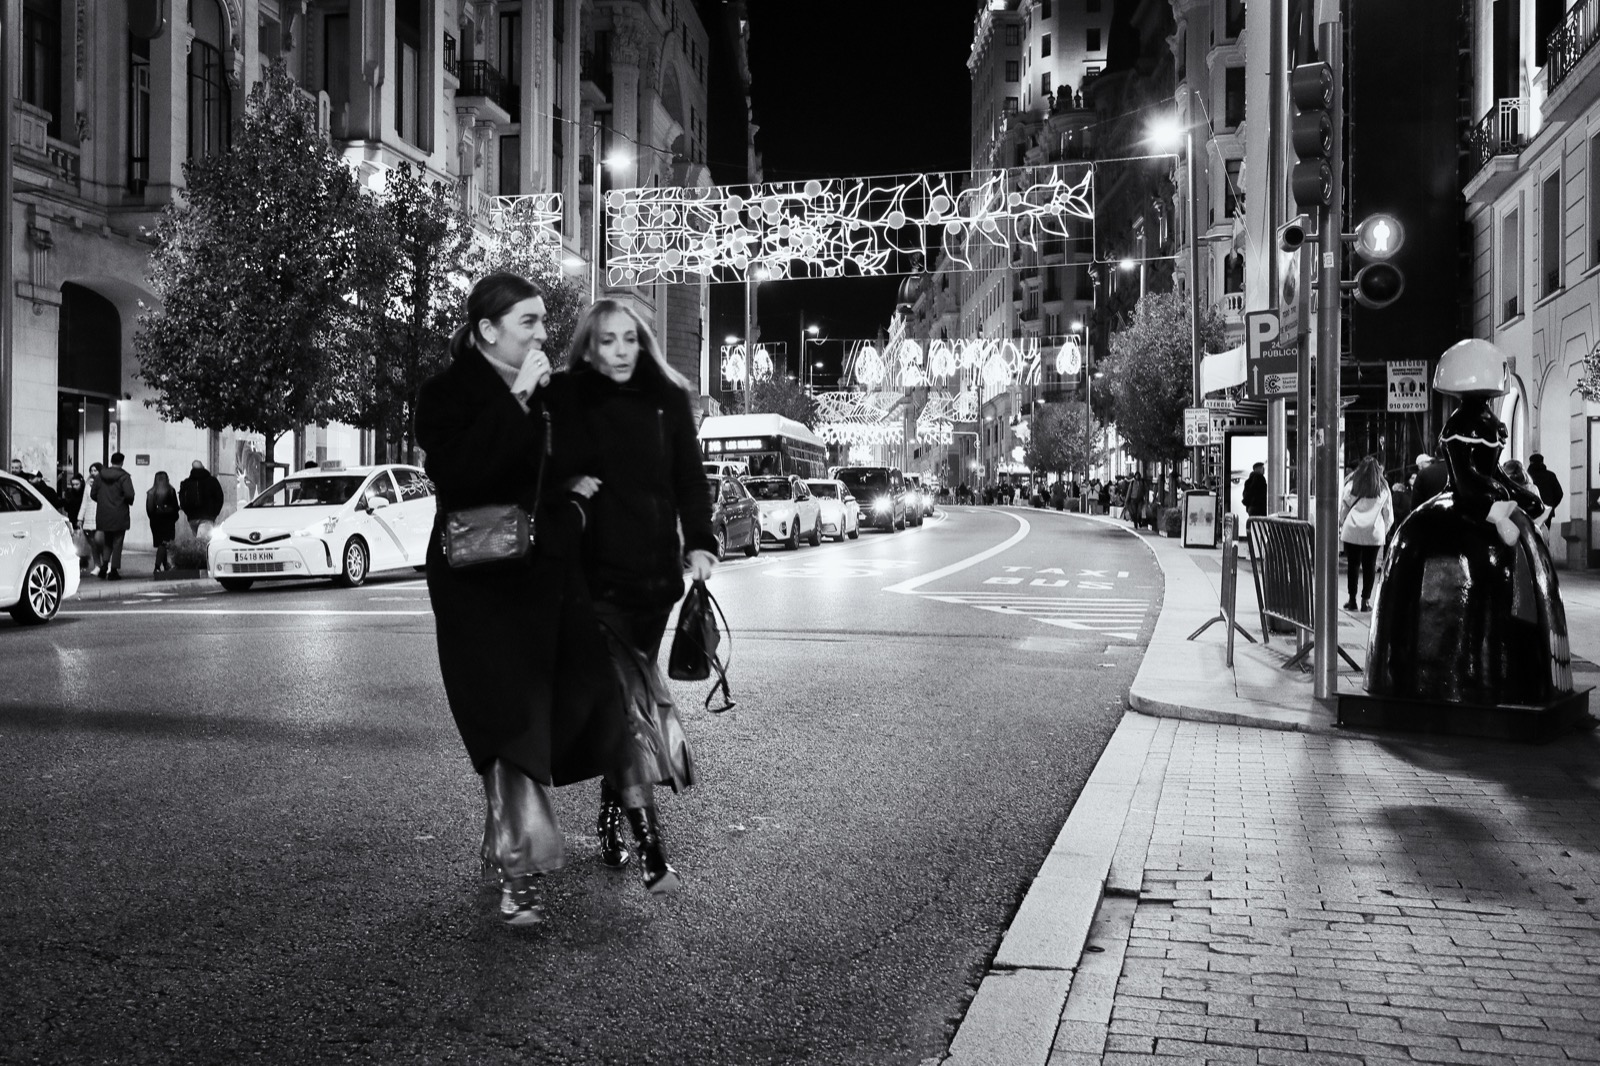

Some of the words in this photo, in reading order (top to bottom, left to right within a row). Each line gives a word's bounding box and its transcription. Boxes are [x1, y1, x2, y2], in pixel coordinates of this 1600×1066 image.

[1249, 313, 1280, 359] P
[1262, 347, 1298, 358] PÚBLICO
[239, 552, 257, 561] 5418
[258, 552, 274, 561] KHN
[1001, 565, 1130, 578] TAXI
[982, 577, 1115, 590] BUS
